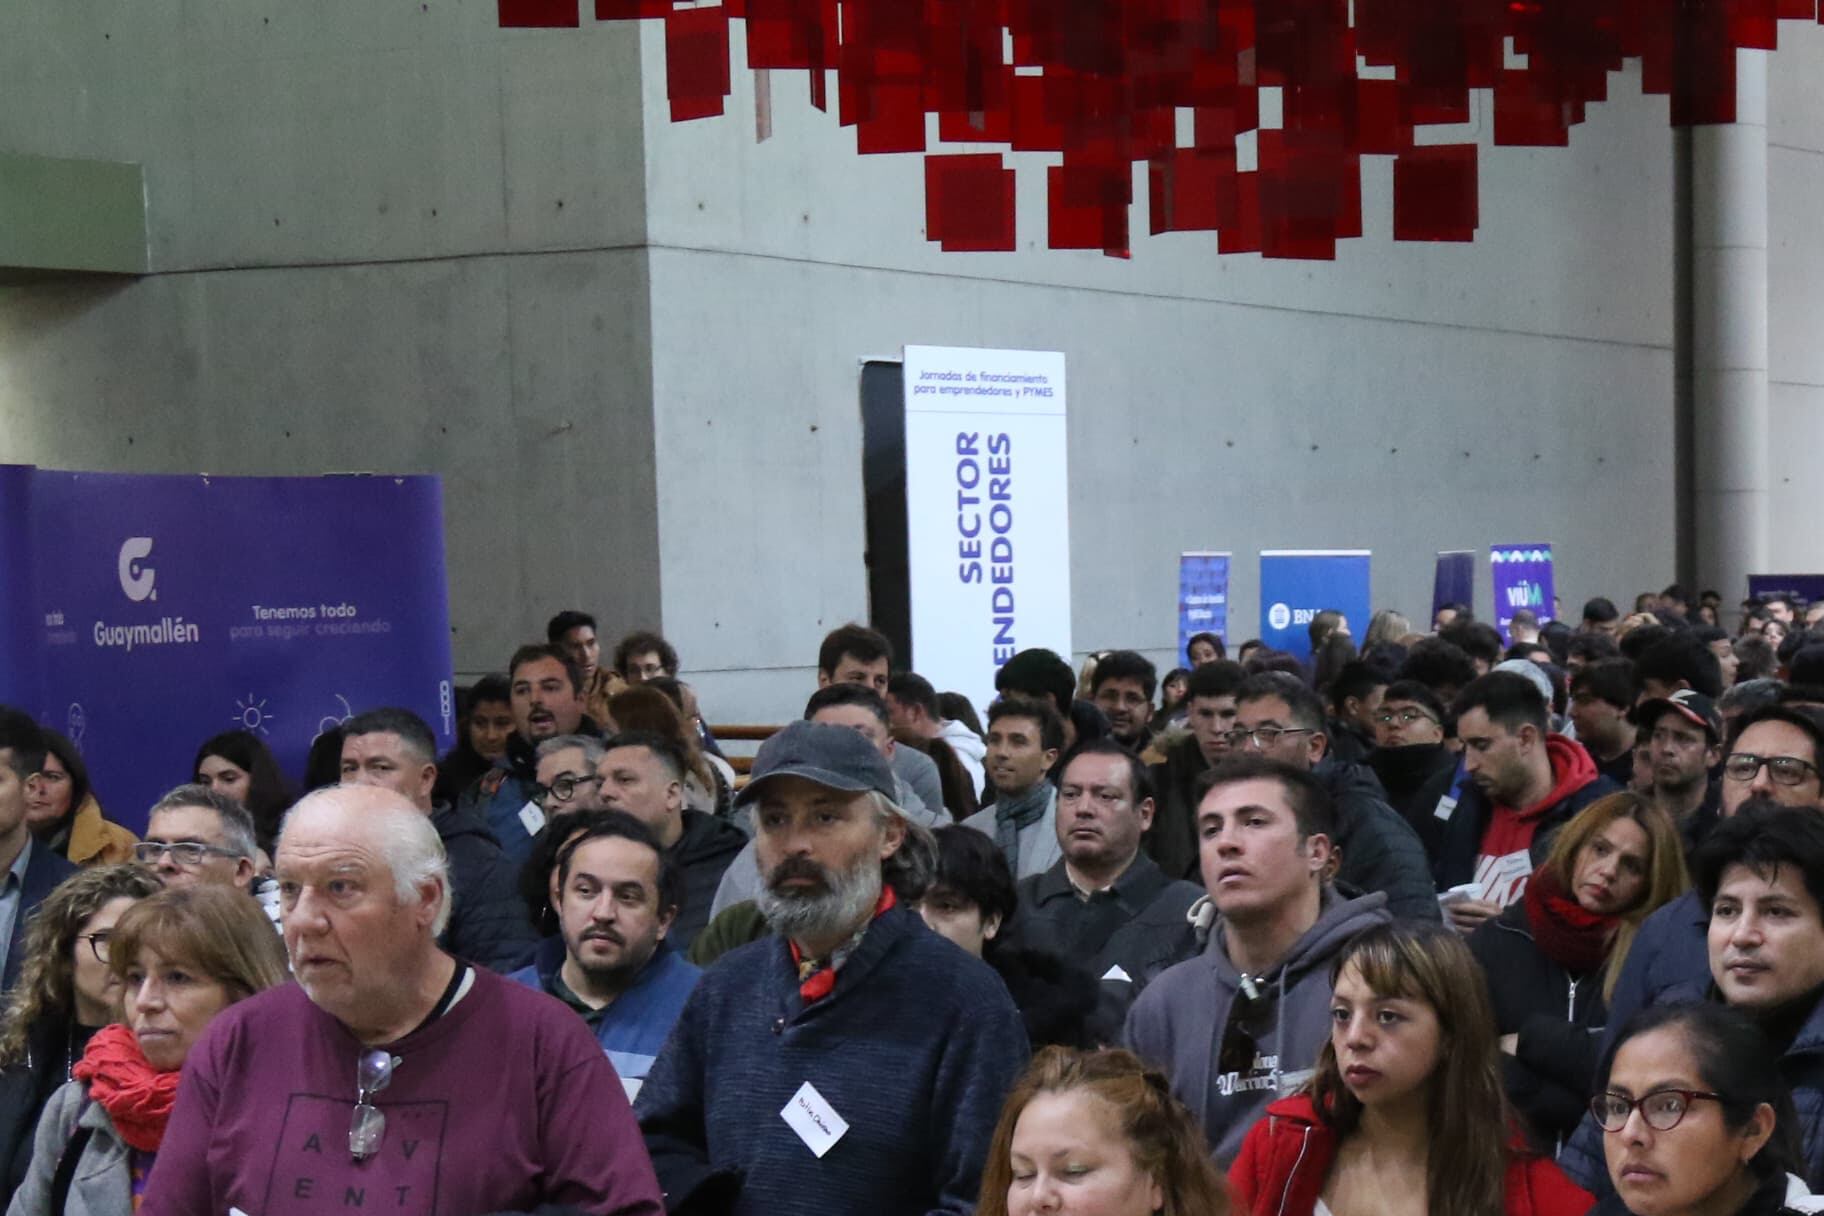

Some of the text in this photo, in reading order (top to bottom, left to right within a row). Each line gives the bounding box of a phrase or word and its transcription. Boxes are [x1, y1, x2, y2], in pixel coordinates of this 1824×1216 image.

[919, 370, 1048, 384] Jornadas de financiamiento
[914, 385, 936, 396] para
[939, 385, 1012, 397] emprendedores
[1023, 387, 1054, 397] PYMES
[956, 431, 982, 584] SECTOR
[987, 432, 1016, 665] ENDEDORES
[252, 603, 357, 620] Tenemos todo
[1294, 608, 1322, 625] BN
[94, 616, 200, 651] Guaymallén
[229, 624, 264, 640] para
